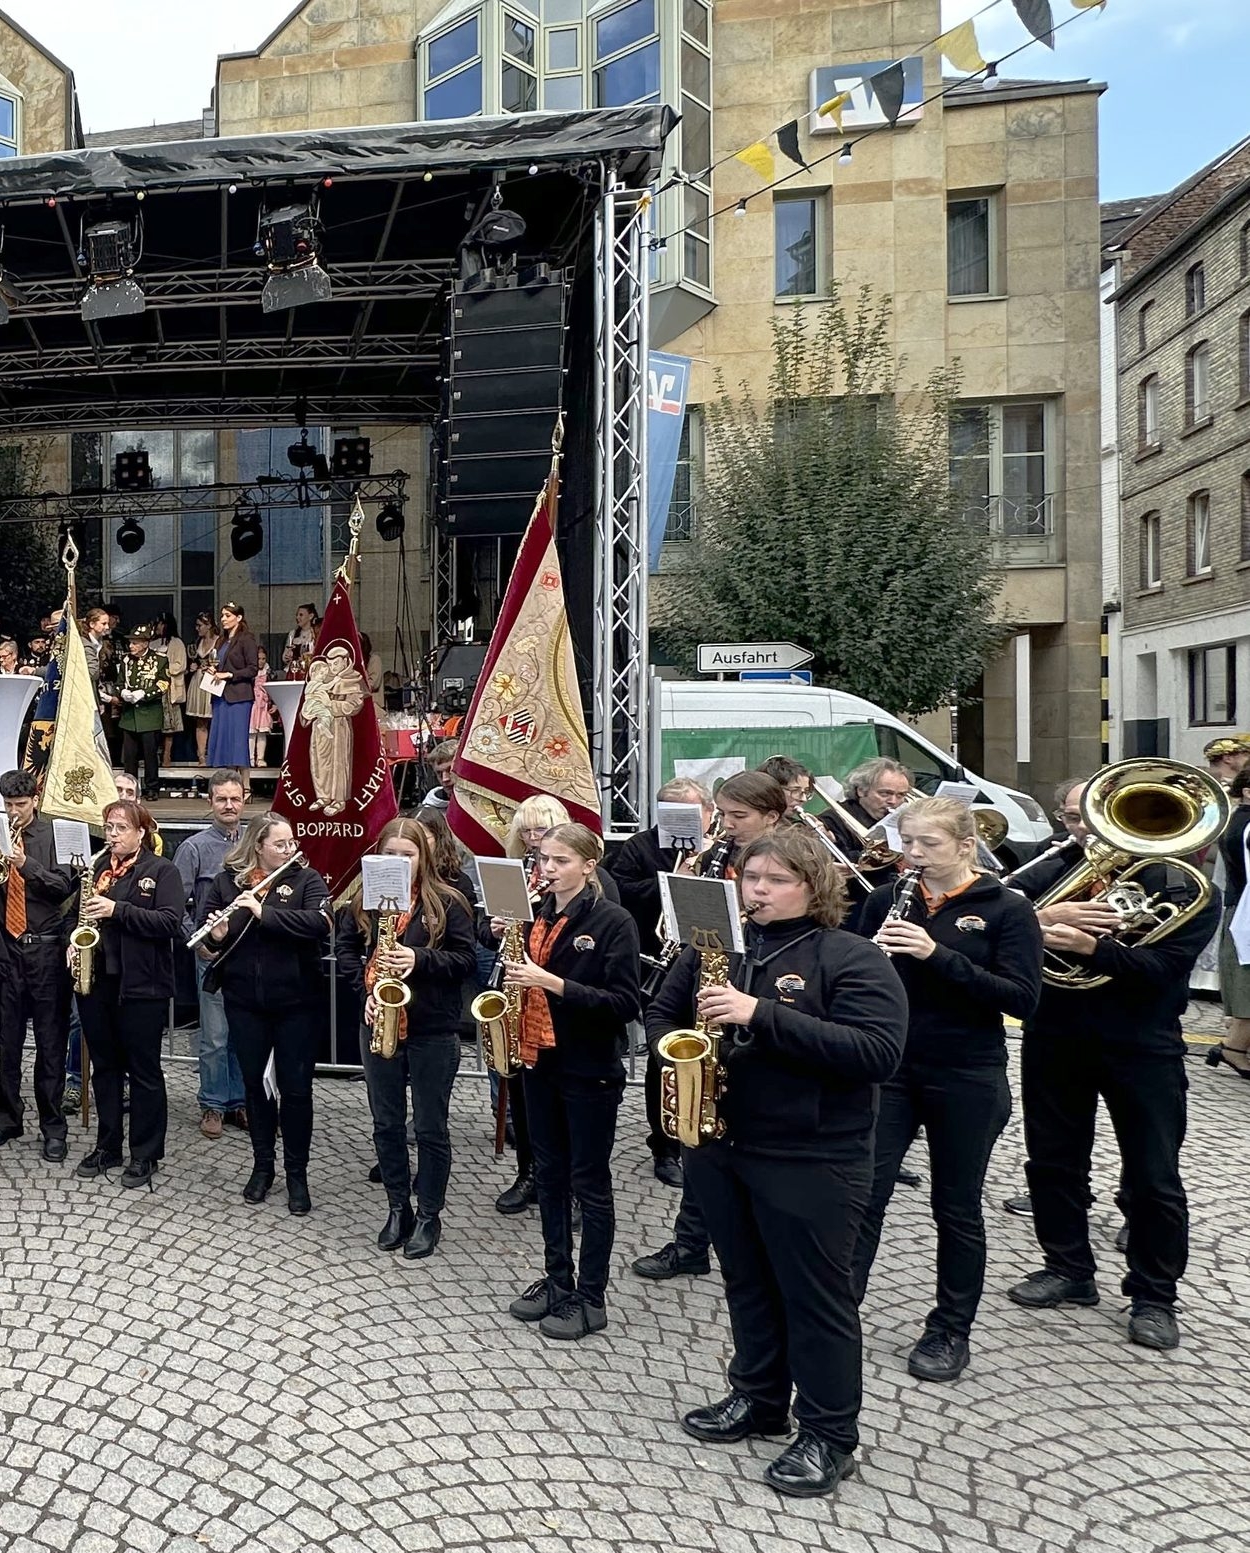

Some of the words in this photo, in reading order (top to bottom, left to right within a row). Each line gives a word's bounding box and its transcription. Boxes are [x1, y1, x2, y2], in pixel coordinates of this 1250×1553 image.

[711, 651, 779, 664] Ausfahrt
[353, 746, 387, 812] SCHAFT
[296, 821, 365, 838] BOPPARD
